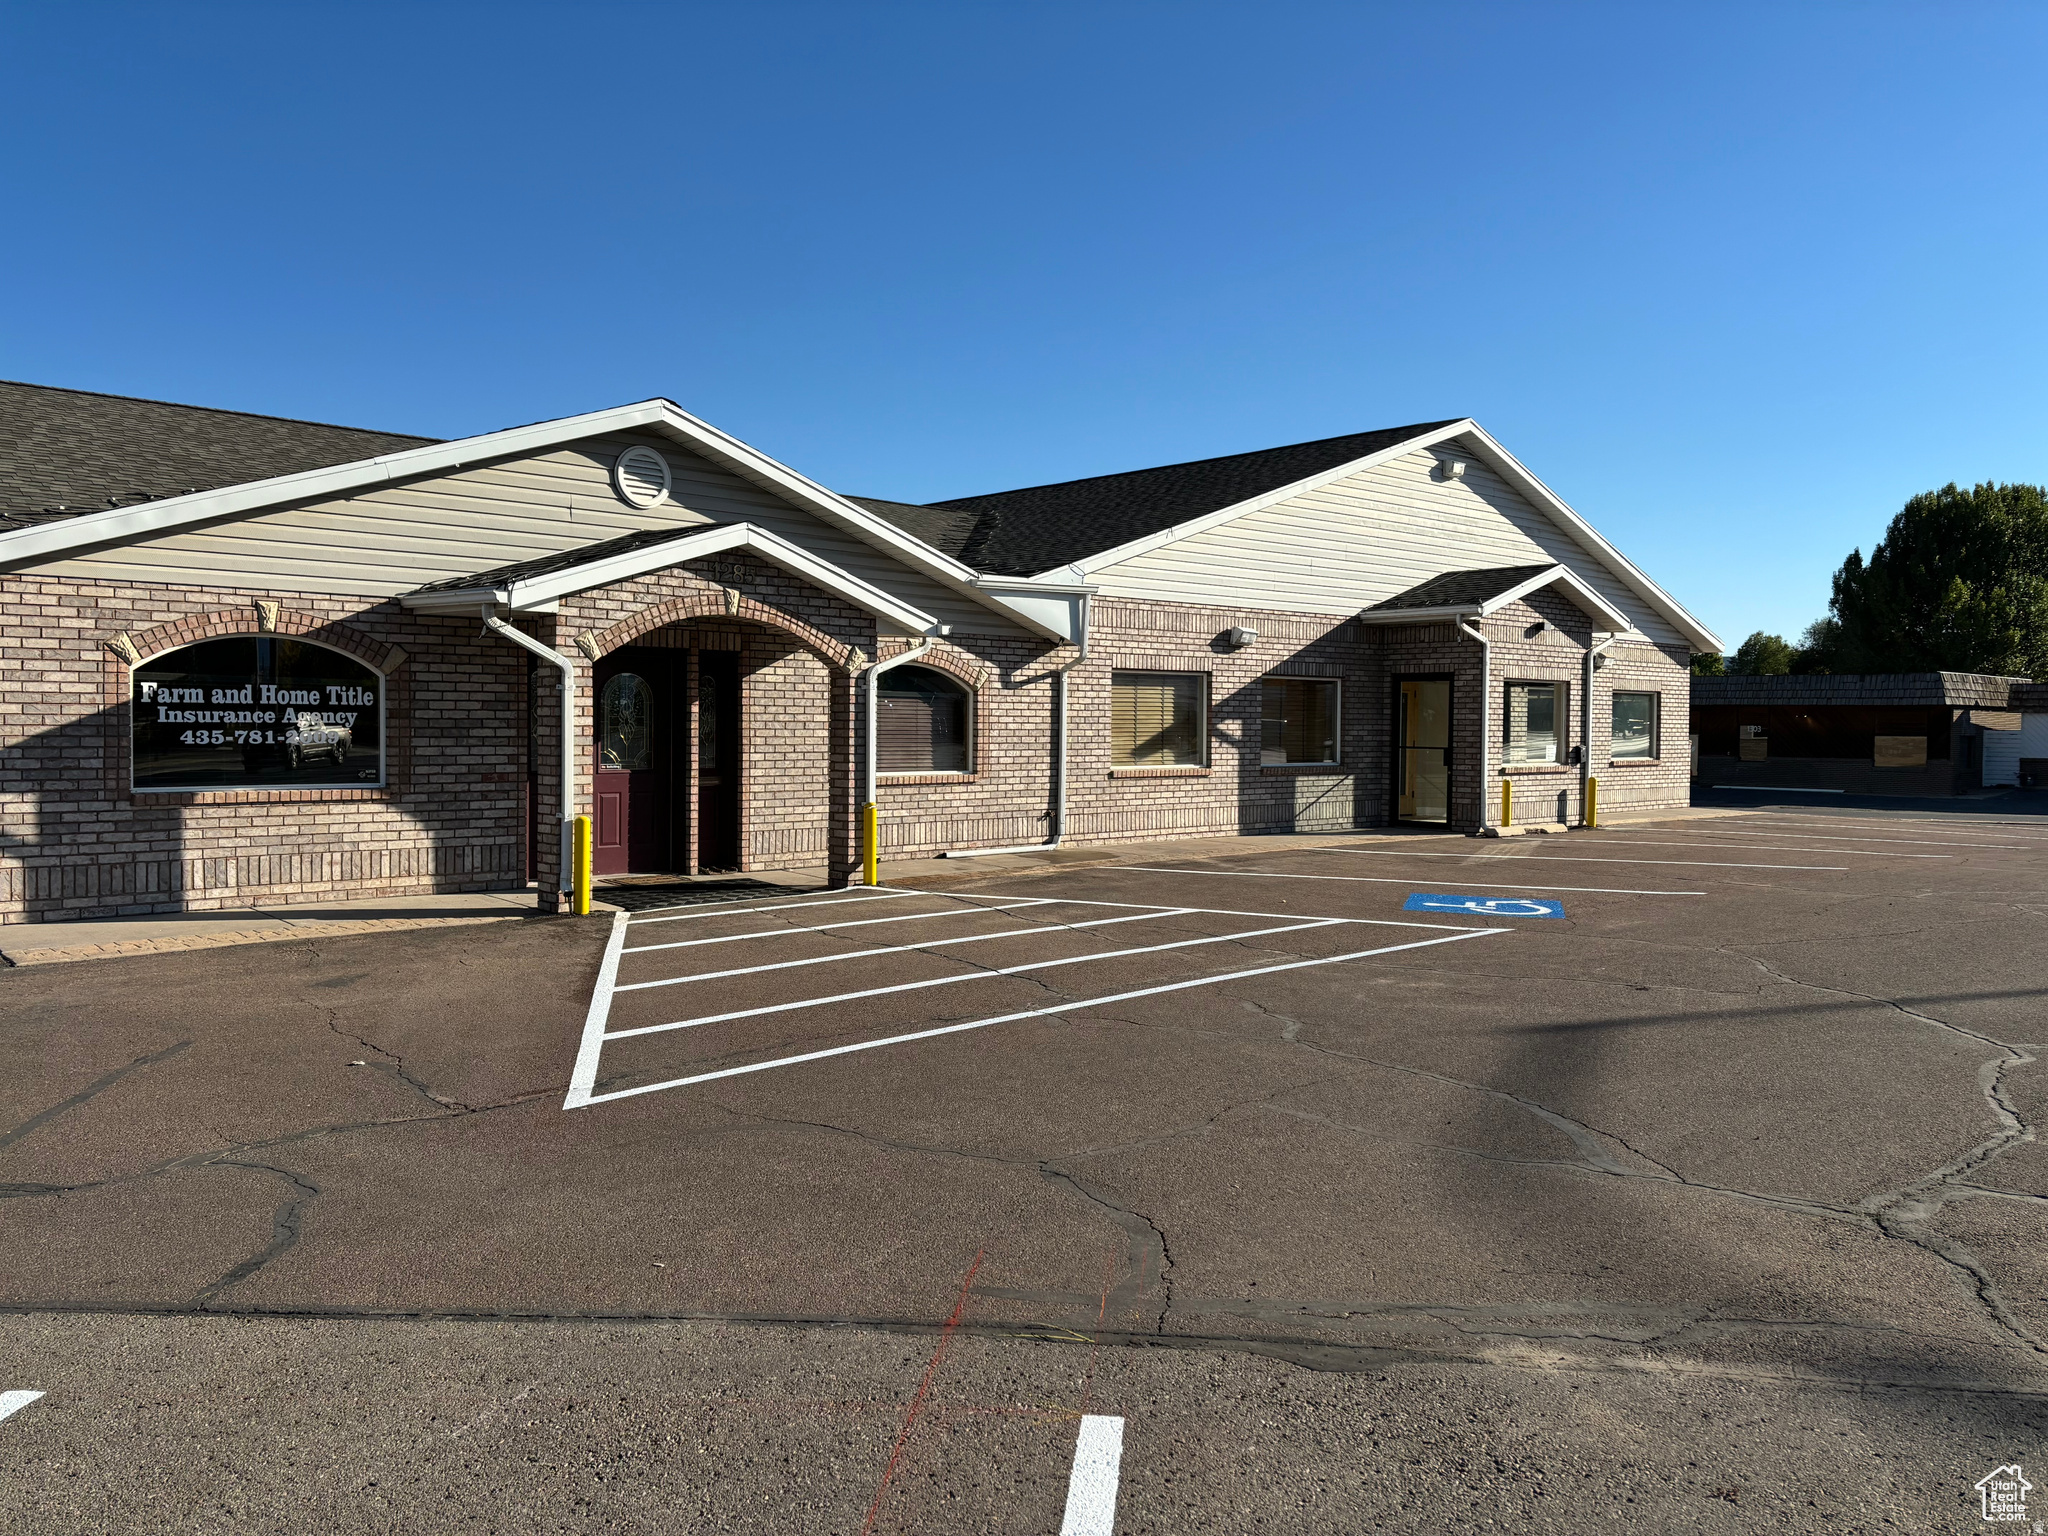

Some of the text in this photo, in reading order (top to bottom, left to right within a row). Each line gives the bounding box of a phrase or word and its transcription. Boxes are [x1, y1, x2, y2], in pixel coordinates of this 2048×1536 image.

[712, 562, 756, 584] 1285
[140, 682, 374, 706] Farm and Home Title
[157, 706, 358, 728] Insurance Agency
[180, 730, 340, 745] 435-781-2009
